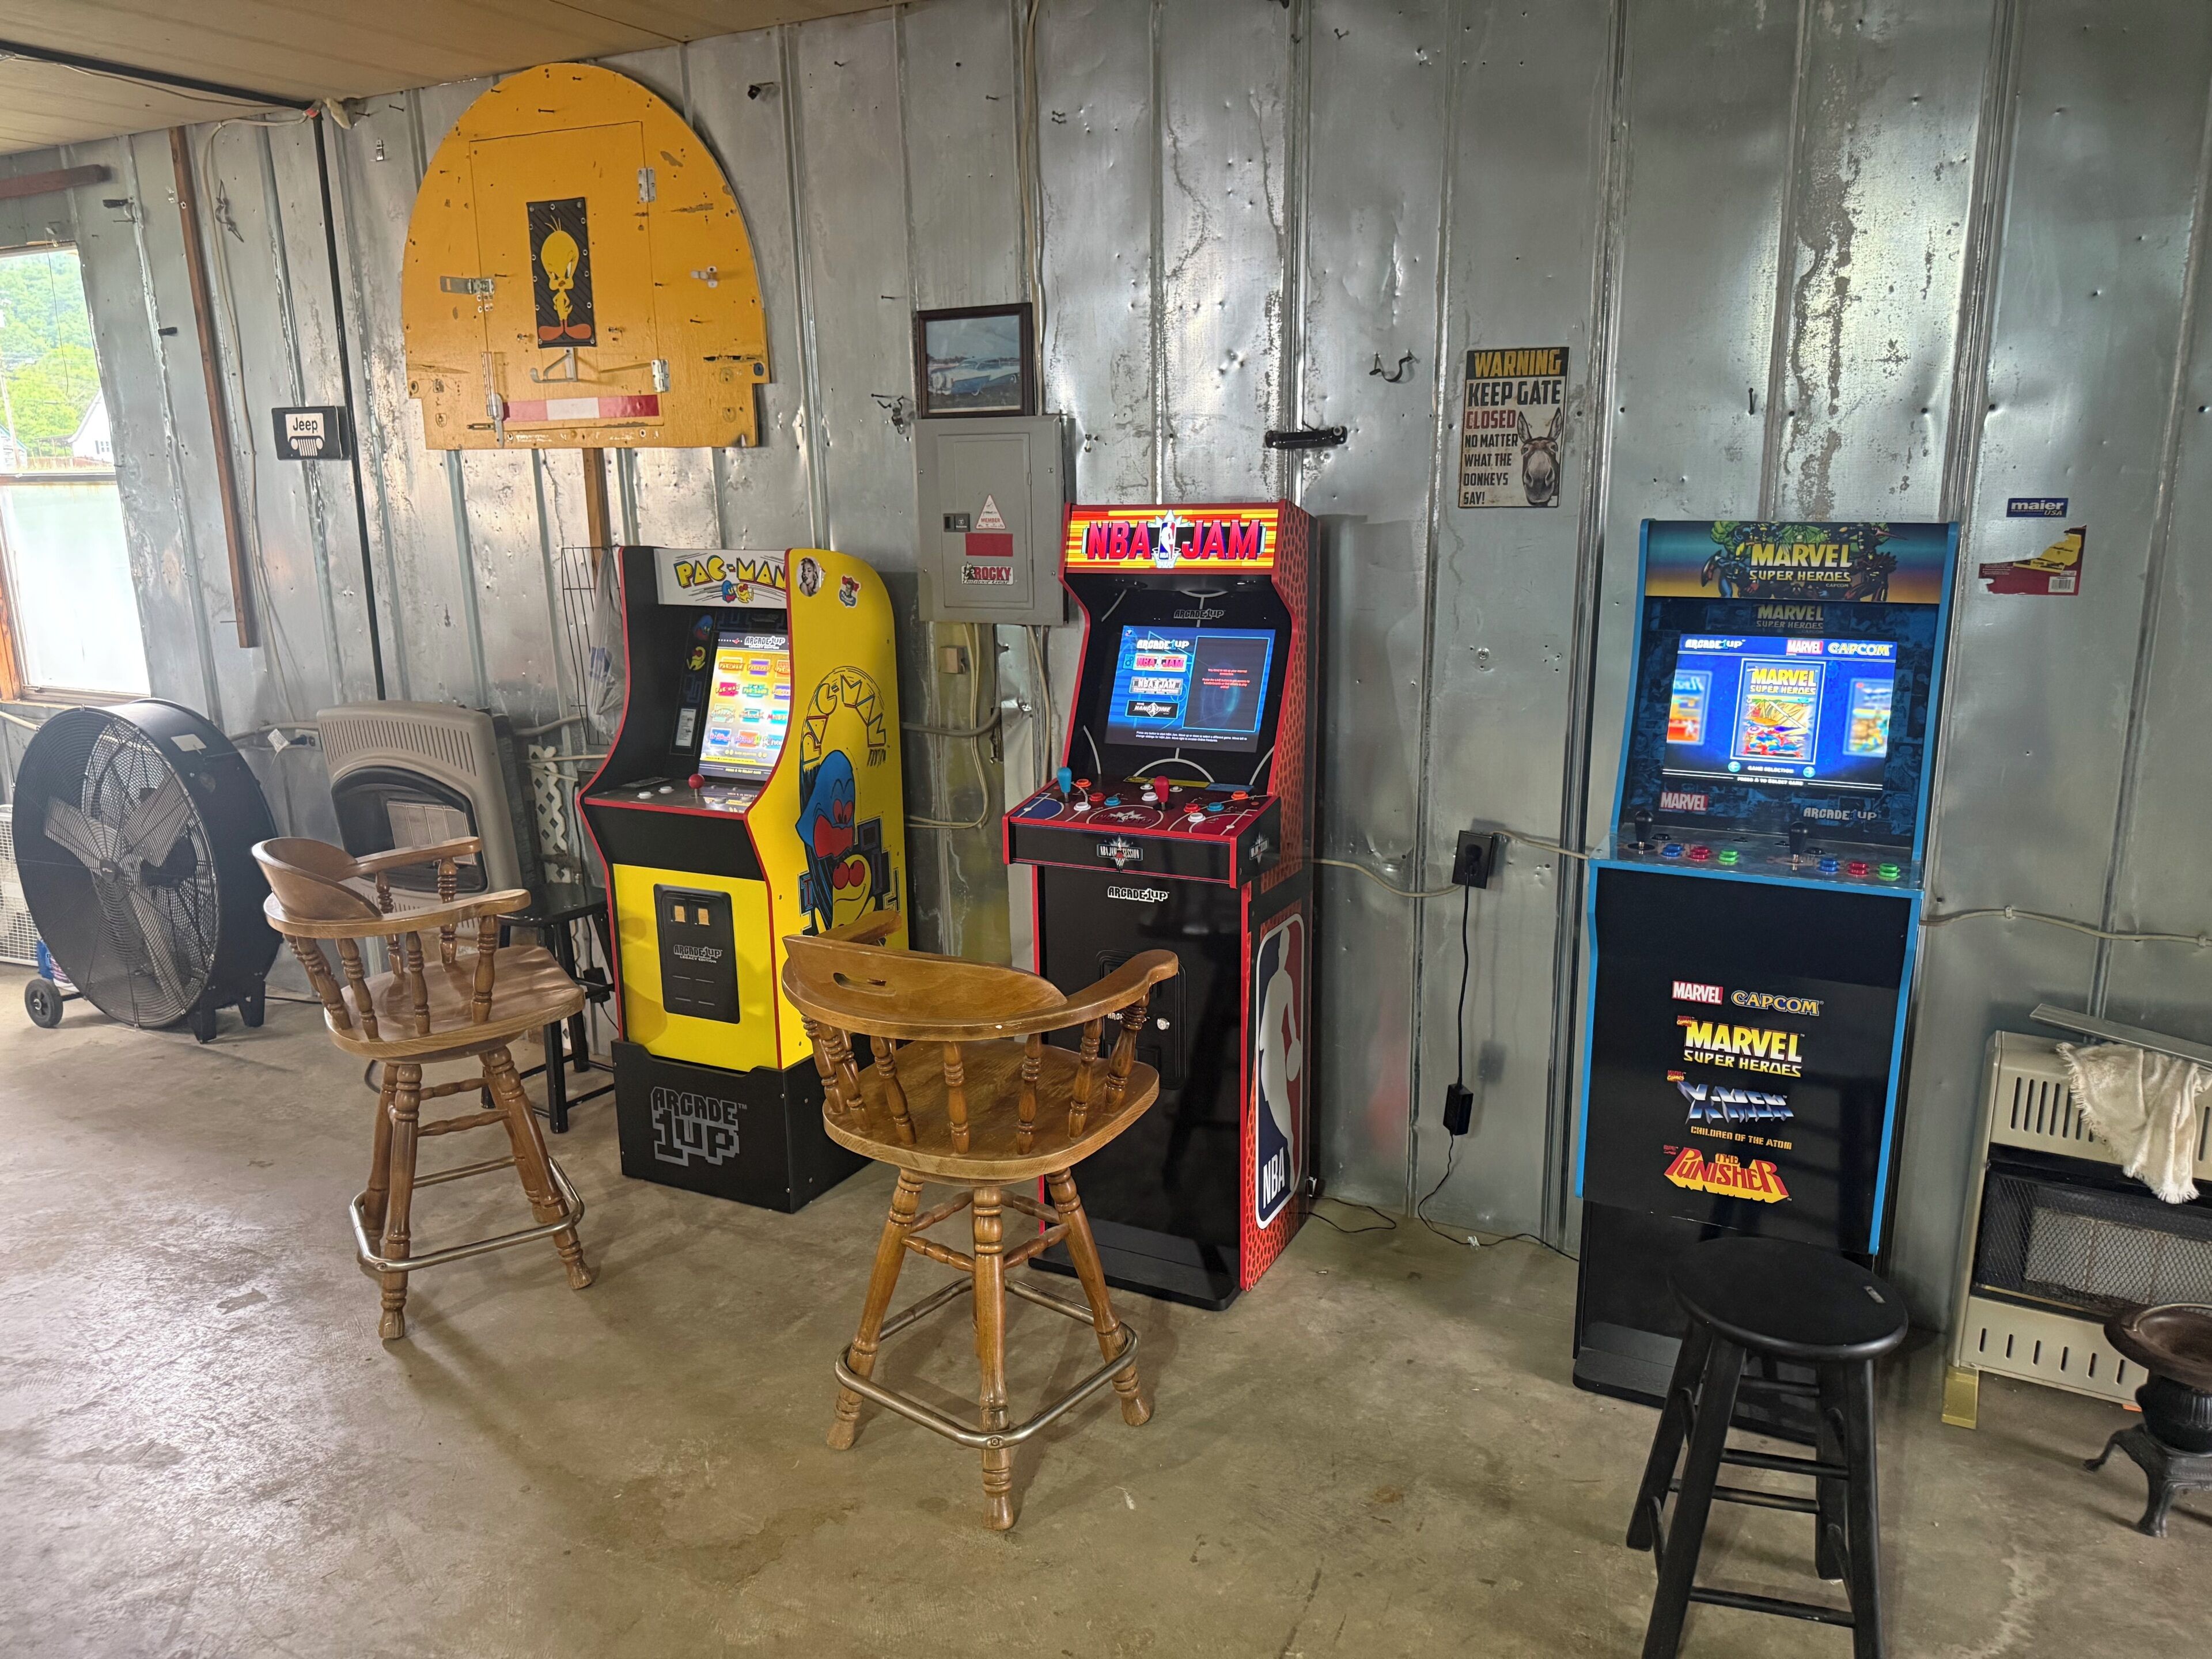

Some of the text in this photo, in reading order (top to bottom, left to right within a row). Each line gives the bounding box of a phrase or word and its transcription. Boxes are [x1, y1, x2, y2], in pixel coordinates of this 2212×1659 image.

[1475, 349, 1562, 378] WARNING
[1468, 380, 1562, 407] KEEP GATE
[293, 417, 318, 433] Jeep
[1466, 410, 1516, 429] CLOSED
[1465, 434, 1518, 448] NO MATTER
[1465, 453, 1512, 467] WHAT THE
[1463, 472, 1508, 486] DONKEYS
[1463, 491, 1485, 505] SAY!
[2011, 500, 2064, 510] maier
[1087, 520, 1261, 560] NBA JAM
[1751, 543, 1853, 567] MARVEL
[674, 555, 786, 590] PAC-MAN
[975, 567, 1011, 581] ROCKY
[1749, 570, 1851, 582] SUPER HEROES
[1758, 604, 1824, 620] MARVEL
[1788, 622, 1823, 630] HEROES
[1787, 639, 1822, 654] MARVEL
[1828, 642, 1890, 656] CAPCOM
[1137, 657, 1184, 668] NBA JAM
[1138, 679, 1176, 690] NBA JAM
[1751, 668, 1816, 687] MARVEL
[1750, 685, 1816, 695] SUPER HEROES
[1660, 793, 1708, 811] MARVEL
[1100, 846, 1108, 856] NBA
[1122, 848, 1139, 859] SESSION
[1108, 886, 1168, 903] ARCADE1UP
[1673, 980, 1722, 1004] MARVEL
[1731, 990, 1819, 1016] CAPCOM
[1685, 1020, 1802, 1063] MARVEL
[1684, 1050, 1802, 1078] SUPER HEROES
[651, 1086, 738, 1127] ARCADE
[1677, 1081, 1794, 1124] X-MEN
[652, 1109, 740, 1166] 1UP
[1691, 1126, 1792, 1150] CHILDREN OF THE ATOM
[1715, 1153, 1740, 1165] THE
[1263, 1146, 1286, 1209] NBA
[1664, 1147, 1789, 1199] PUNISHER
